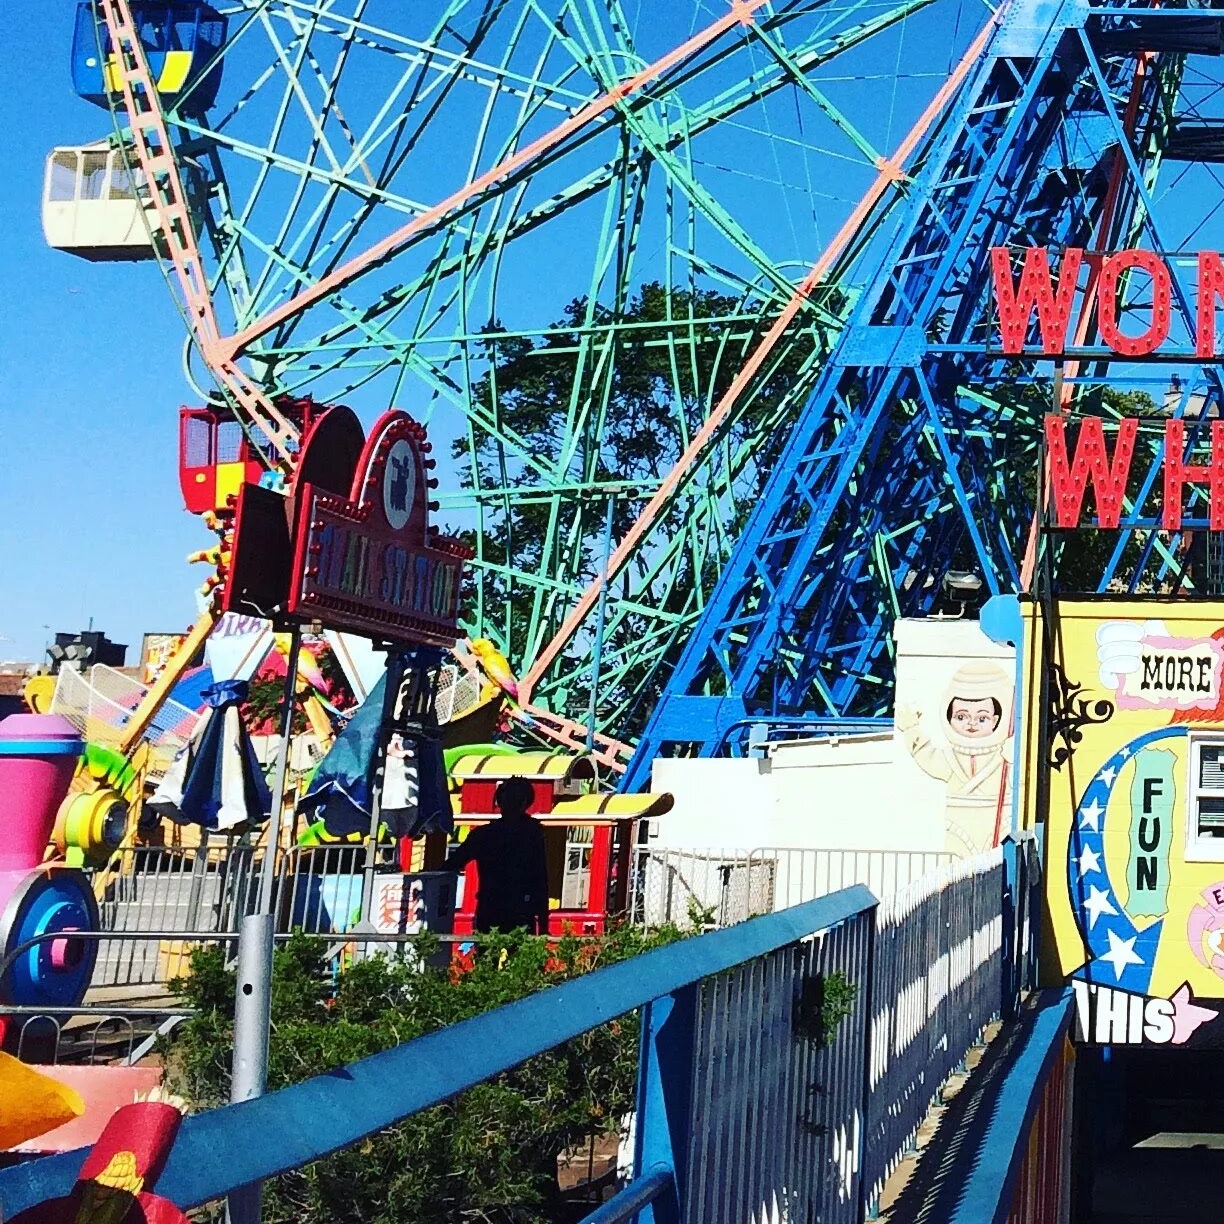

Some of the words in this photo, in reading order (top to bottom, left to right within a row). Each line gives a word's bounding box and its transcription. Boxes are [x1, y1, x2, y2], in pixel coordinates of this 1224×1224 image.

[1140, 654, 1212, 693] MORE
[1135, 777, 1164, 891] FUN
[1072, 979, 1176, 1044] THIS
